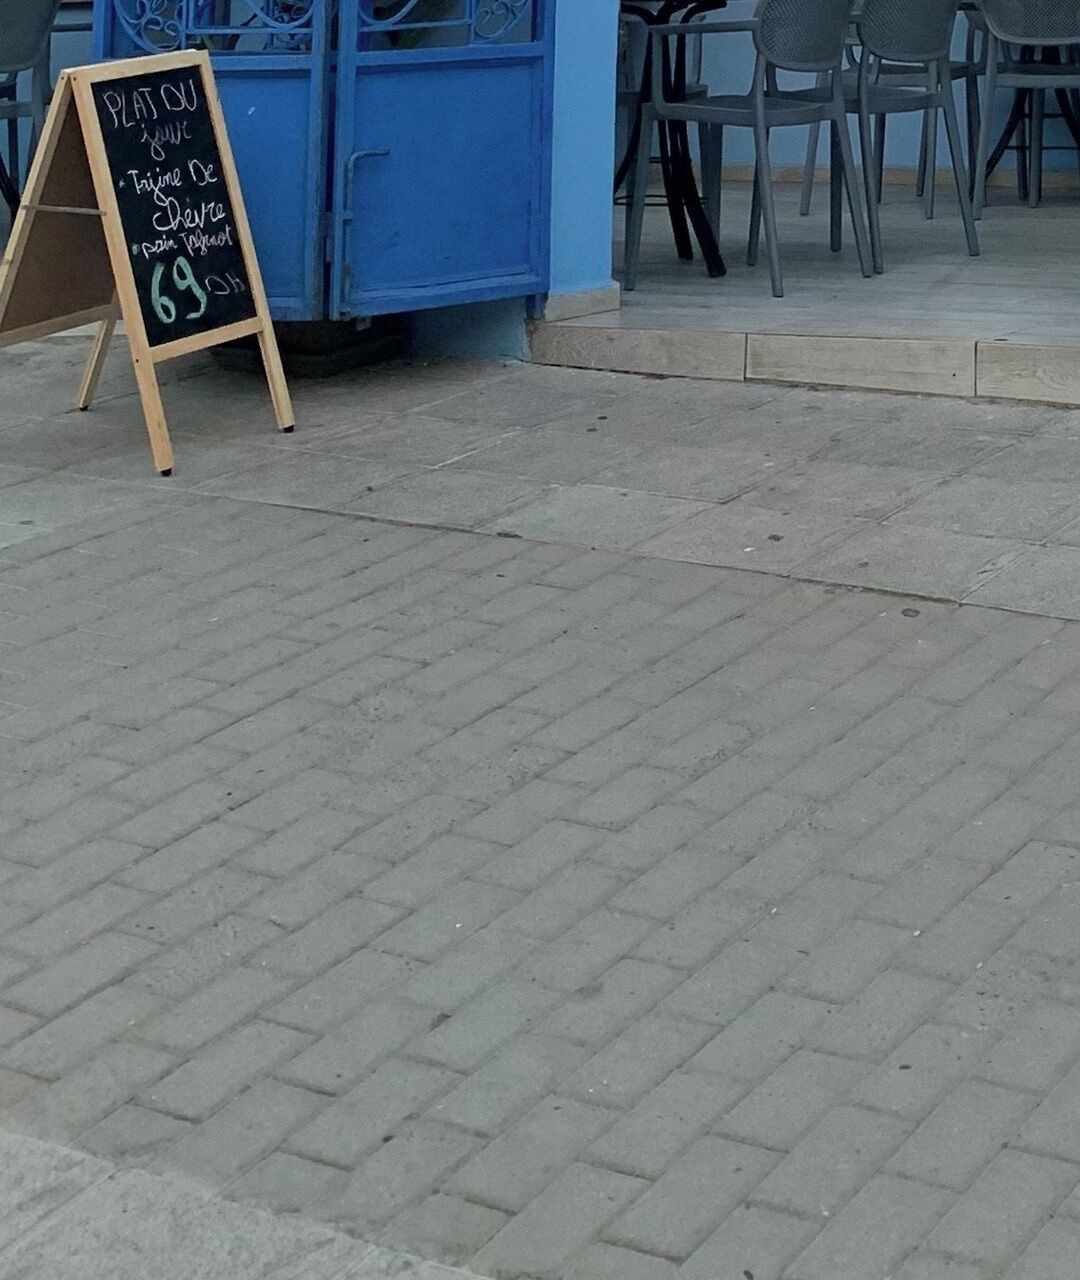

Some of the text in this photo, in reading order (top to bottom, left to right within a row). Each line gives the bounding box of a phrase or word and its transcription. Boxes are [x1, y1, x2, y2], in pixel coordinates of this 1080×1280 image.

[102, 79, 198, 129] PLAT DU
[151, 255, 208, 324] 69
